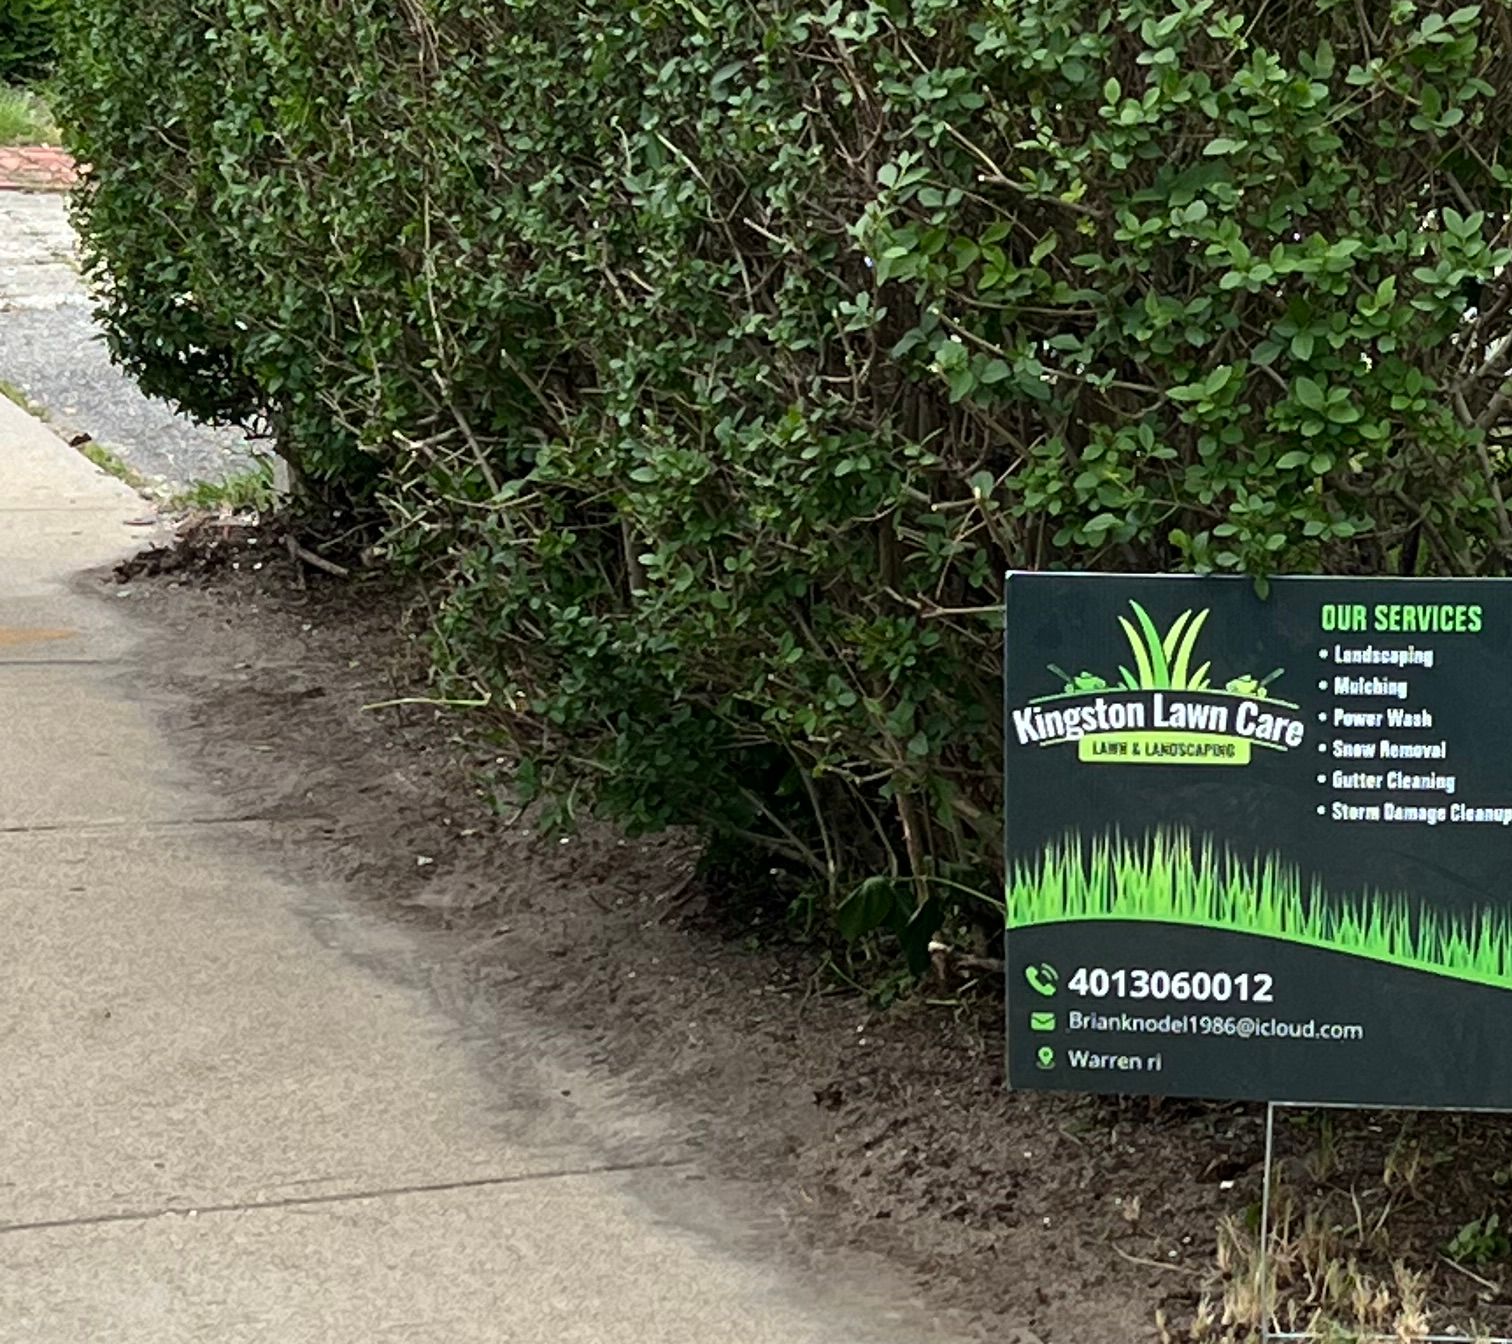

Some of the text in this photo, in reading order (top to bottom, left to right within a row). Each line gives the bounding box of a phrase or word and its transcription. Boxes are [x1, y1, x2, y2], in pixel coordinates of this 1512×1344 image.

[1322, 604, 1482, 632] OUR SERVICES
[1334, 644, 1434, 668] Landscaping
[1334, 676, 1408, 699] Mulching
[1012, 693, 1304, 747] Kingston Lawn Care
[1333, 708, 1433, 727] Power Wash
[1092, 740, 1236, 758] LAWN & LANDSCAPING
[1332, 739, 1447, 758] Snow Removal
[1332, 770, 1456, 794] Gutter Cleaning
[1331, 802, 1380, 821] Storm
[1383, 802, 1447, 825] Damage
[1068, 967, 1274, 1003] 4013060012
[1068, 1010, 1363, 1040] Brianknodel1986@icloud.com
[1068, 1049, 1162, 1071] Warren ri
